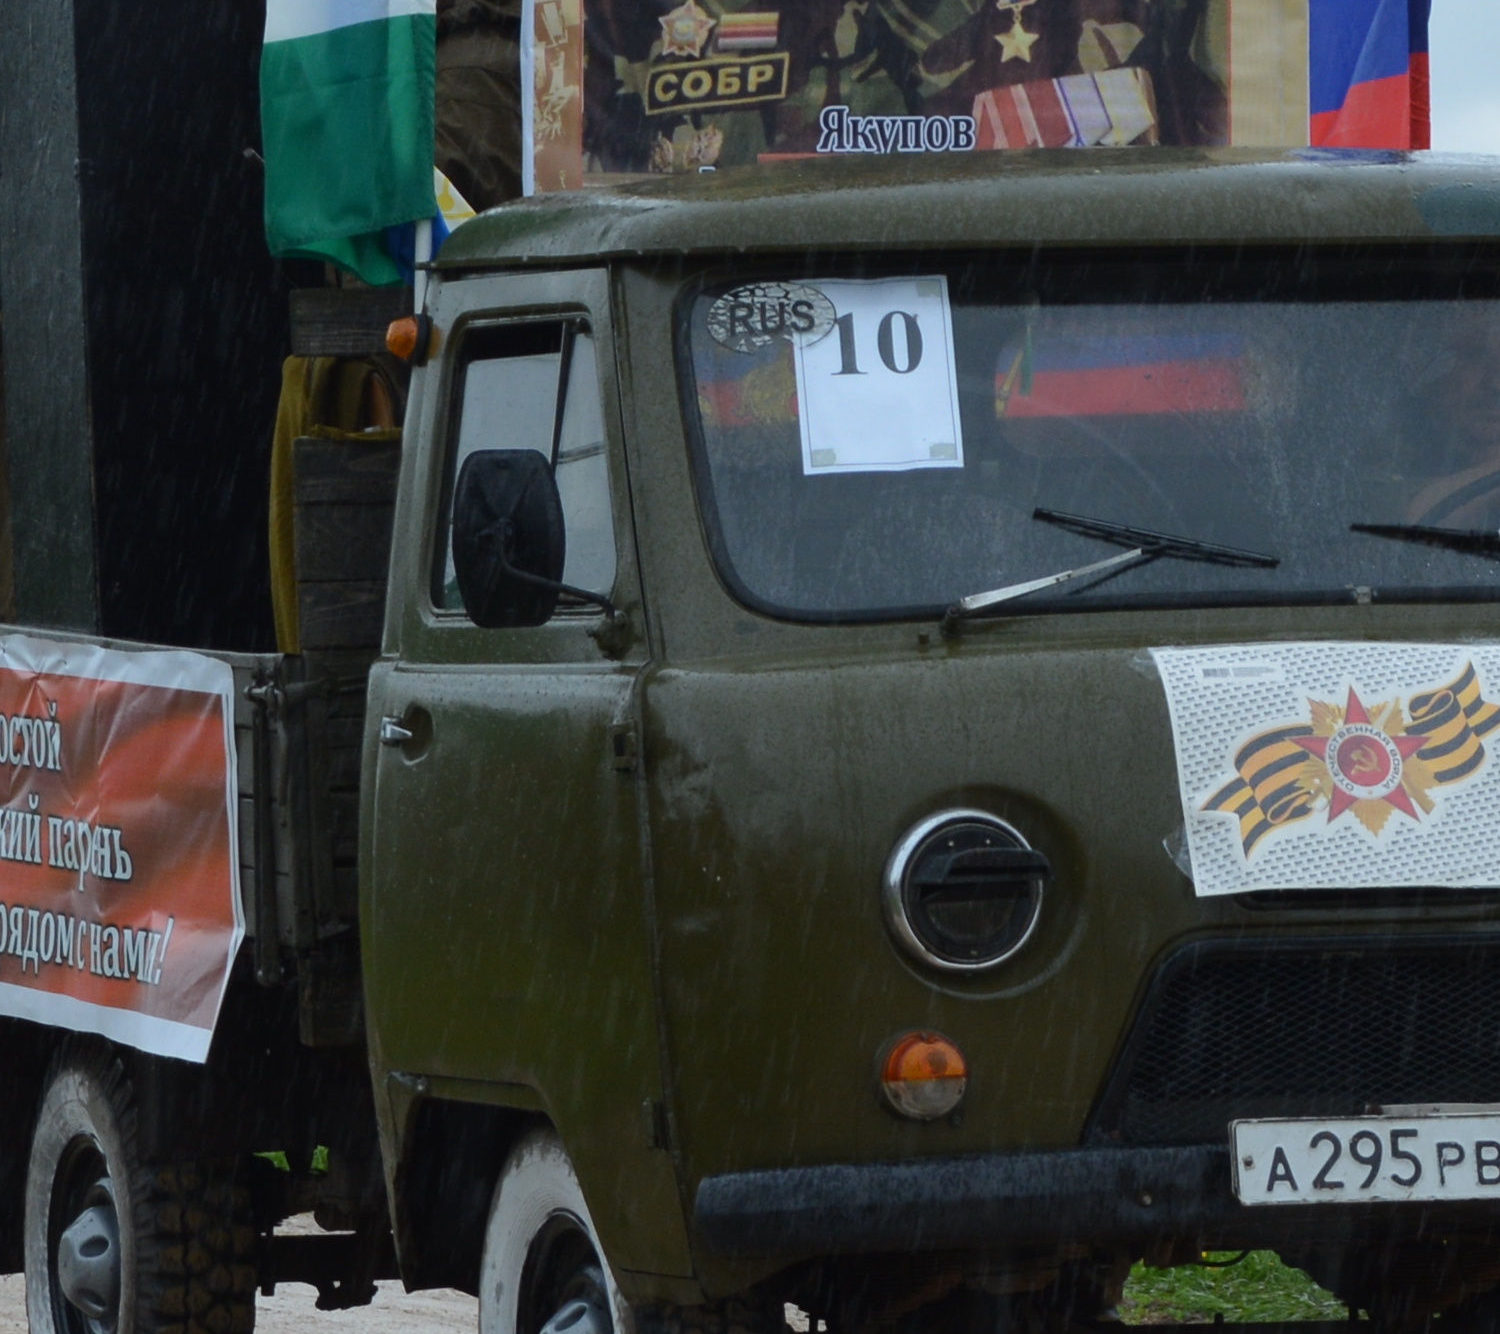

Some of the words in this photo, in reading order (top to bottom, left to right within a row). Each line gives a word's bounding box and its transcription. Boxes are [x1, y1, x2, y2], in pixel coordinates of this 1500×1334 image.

[654, 65, 774, 102] СОБР
[816, 105, 976, 154] Якупов
[729, 300, 815, 337] RUS
[830, 310, 924, 375] 10
[48, 816, 133, 892] парень
[90, 917, 174, 985] нами!
